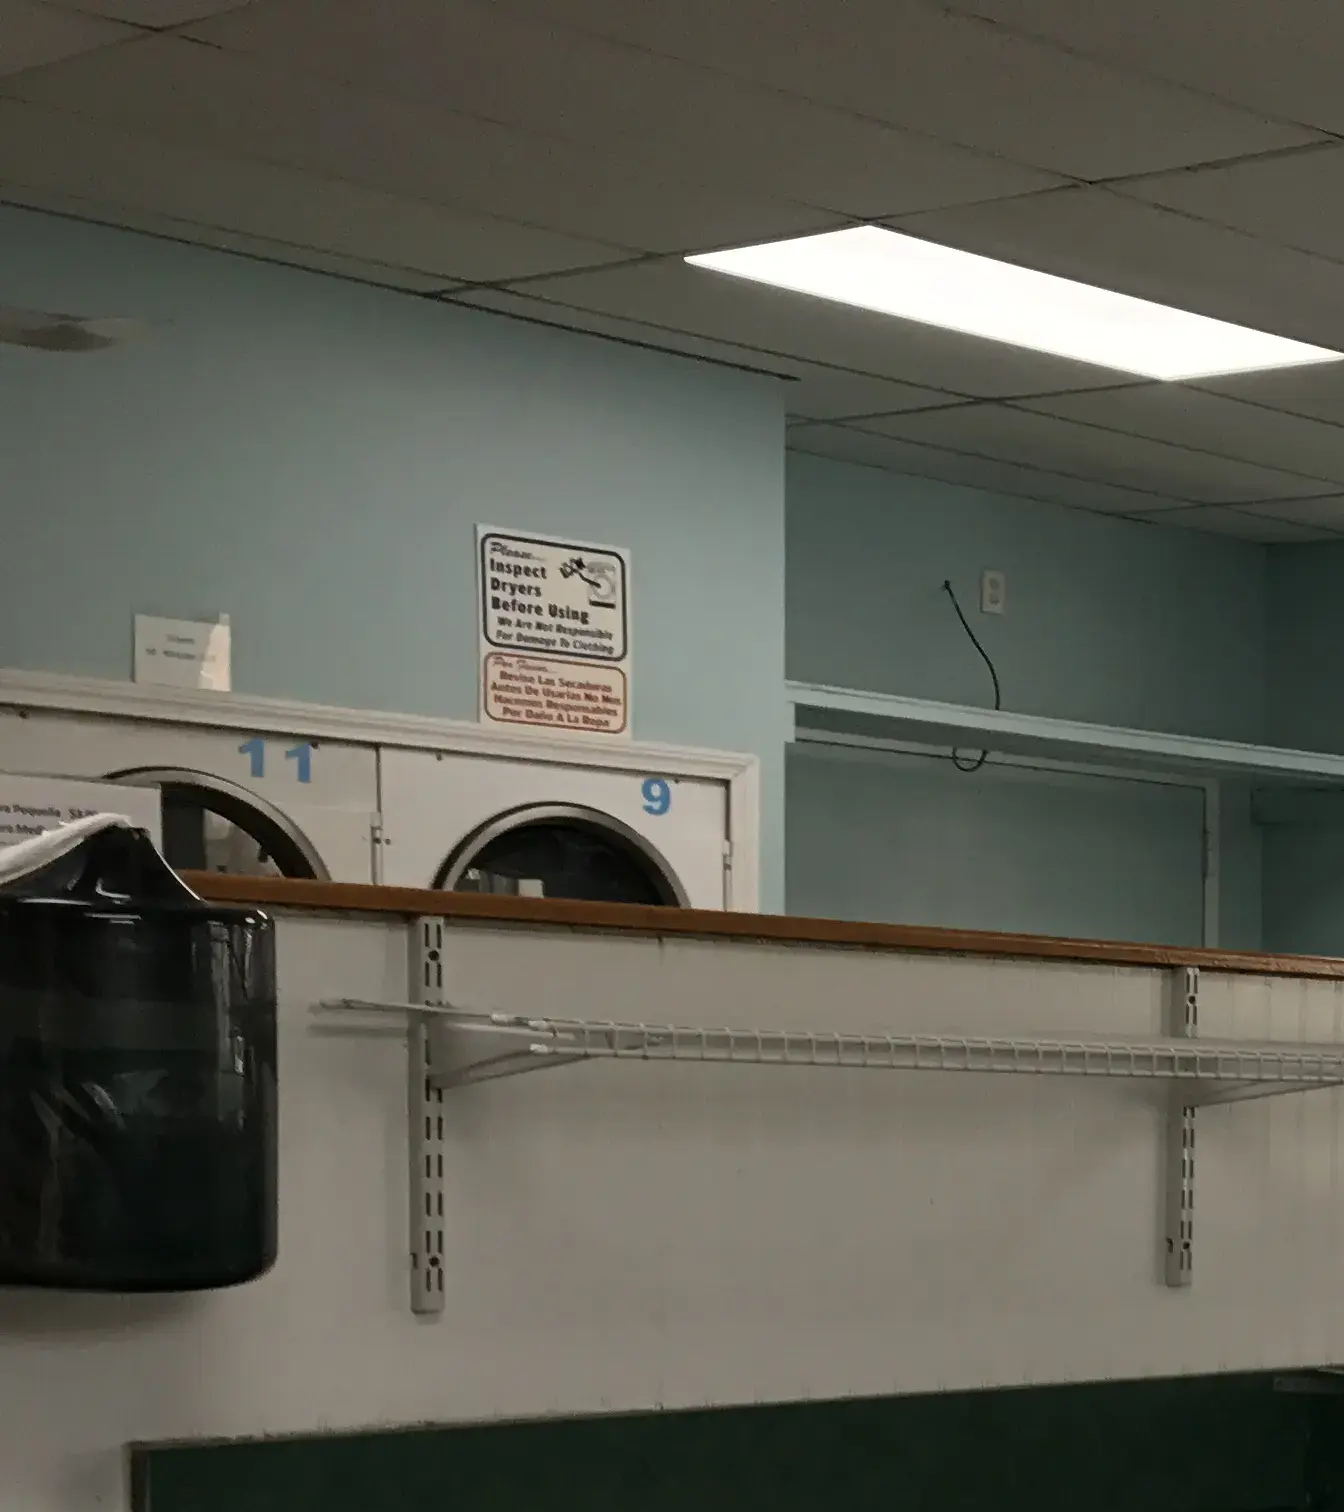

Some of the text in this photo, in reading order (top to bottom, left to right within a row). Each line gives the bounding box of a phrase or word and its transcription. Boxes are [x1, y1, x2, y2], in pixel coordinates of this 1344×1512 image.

[489, 558, 547, 579] Inspect
[489, 577, 542, 597] Dryers
[491, 596, 589, 625] Before Using
[238, 737, 313, 784] 11
[640, 777, 671, 817] 9
